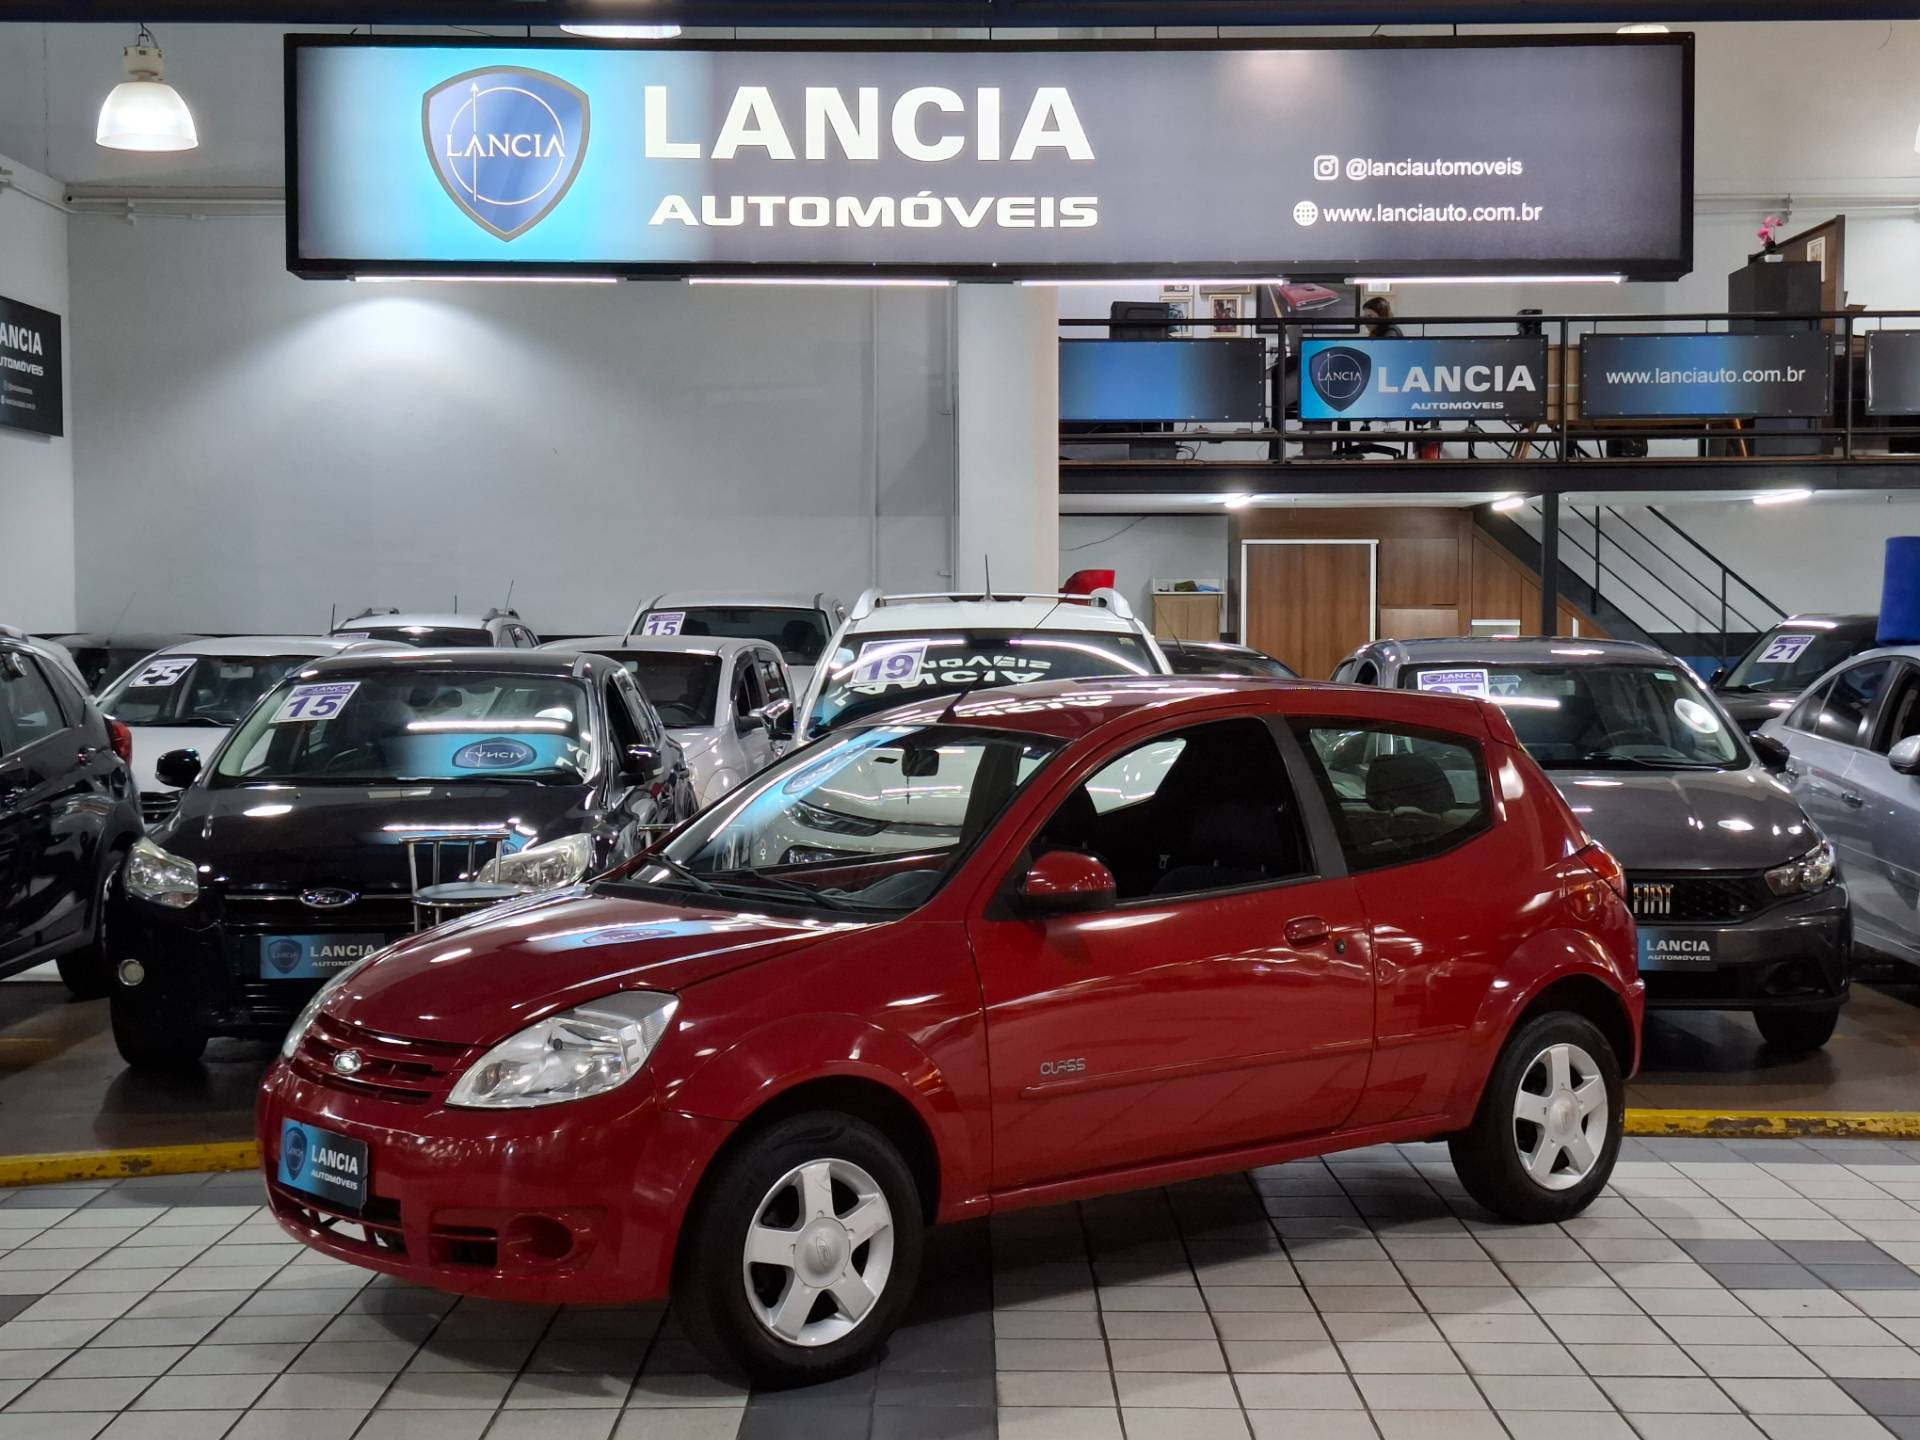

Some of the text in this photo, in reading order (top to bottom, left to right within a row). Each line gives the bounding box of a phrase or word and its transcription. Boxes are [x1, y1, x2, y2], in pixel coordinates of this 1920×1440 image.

[644, 85, 1096, 162] LANCIA
[446, 133, 566, 157] LANCIA
[1346, 157, 1523, 181] @lanciautomoveis
[648, 190, 1099, 228] AUTOMÓVEIS
[1323, 203, 1544, 222] www.lanciauto.com.br
[0, 322, 43, 356] ANCIA
[1317, 371, 1362, 382] LANCIA
[1378, 365, 1537, 393] LANCIA
[1606, 366, 1806, 386] www.lanciauto.com.br
[648, 621, 678, 636] 15
[1765, 645, 1802, 660] 21
[863, 655, 914, 681] 19
[1442, 672, 1483, 680] LANCIA
[287, 695, 344, 718] 15
[1633, 882, 1675, 914] FIAT
[310, 944, 376, 958] LANCIA
[1646, 940, 1710, 952] LANCIA
[311, 1144, 359, 1175] LANCIA
